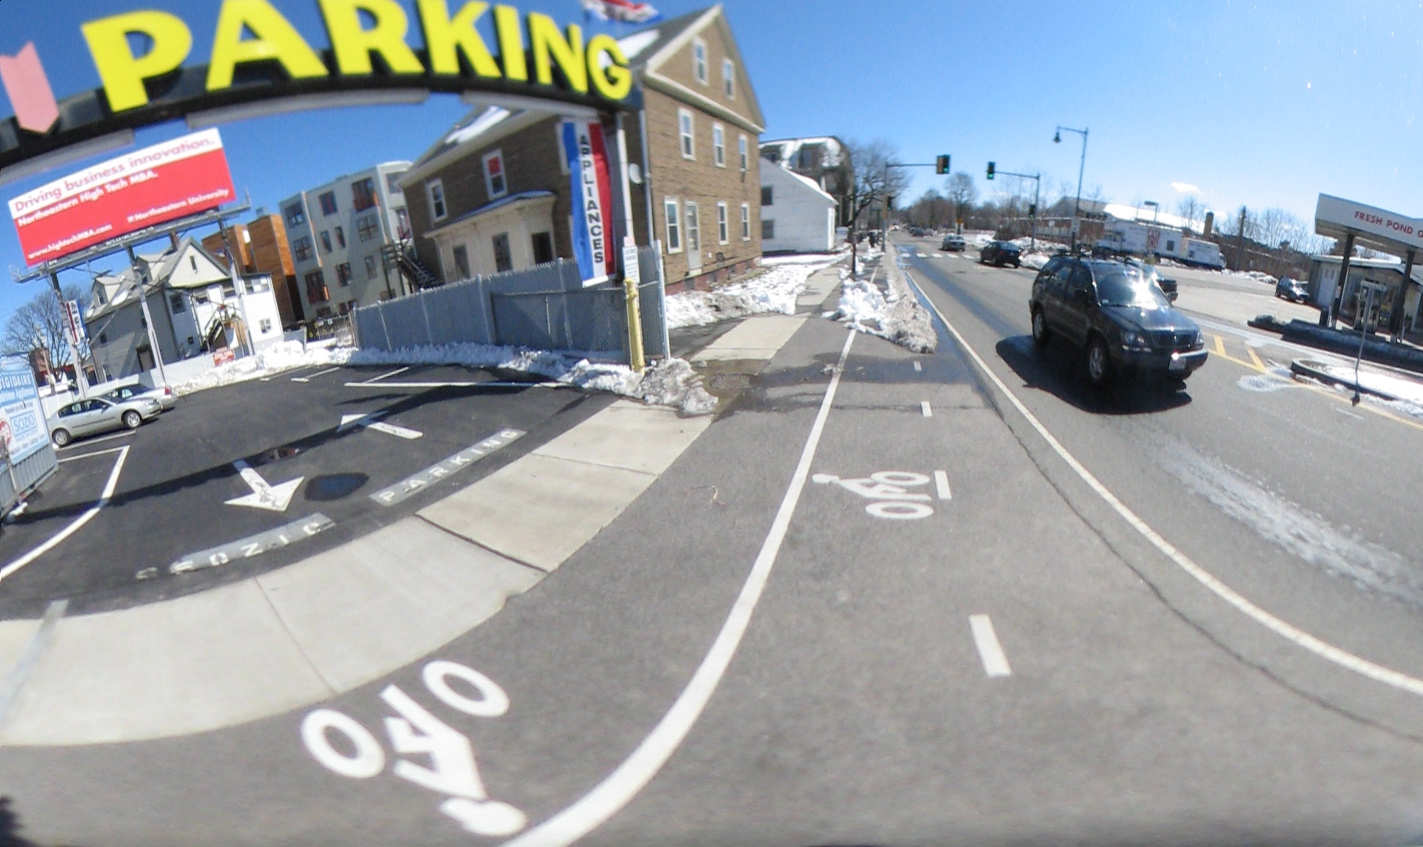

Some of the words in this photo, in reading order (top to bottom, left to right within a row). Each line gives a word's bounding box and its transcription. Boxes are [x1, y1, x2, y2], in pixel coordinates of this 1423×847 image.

[83, 0, 634, 112] PARKING
[14, 187, 62, 212] Driving
[64, 164, 125, 191] business
[128, 137, 215, 168] innovation.
[18, 198, 79, 227] Northeastern
[80, 186, 104, 202] High
[105, 177, 128, 193] Tech
[579, 134, 604, 263] APPLIANCES
[1354, 210, 1383, 226] FRESH
[1386, 219, 1413, 235] POND
[13, 414, 36, 433] SOZIO
[378, 430, 518, 501] PARKING
